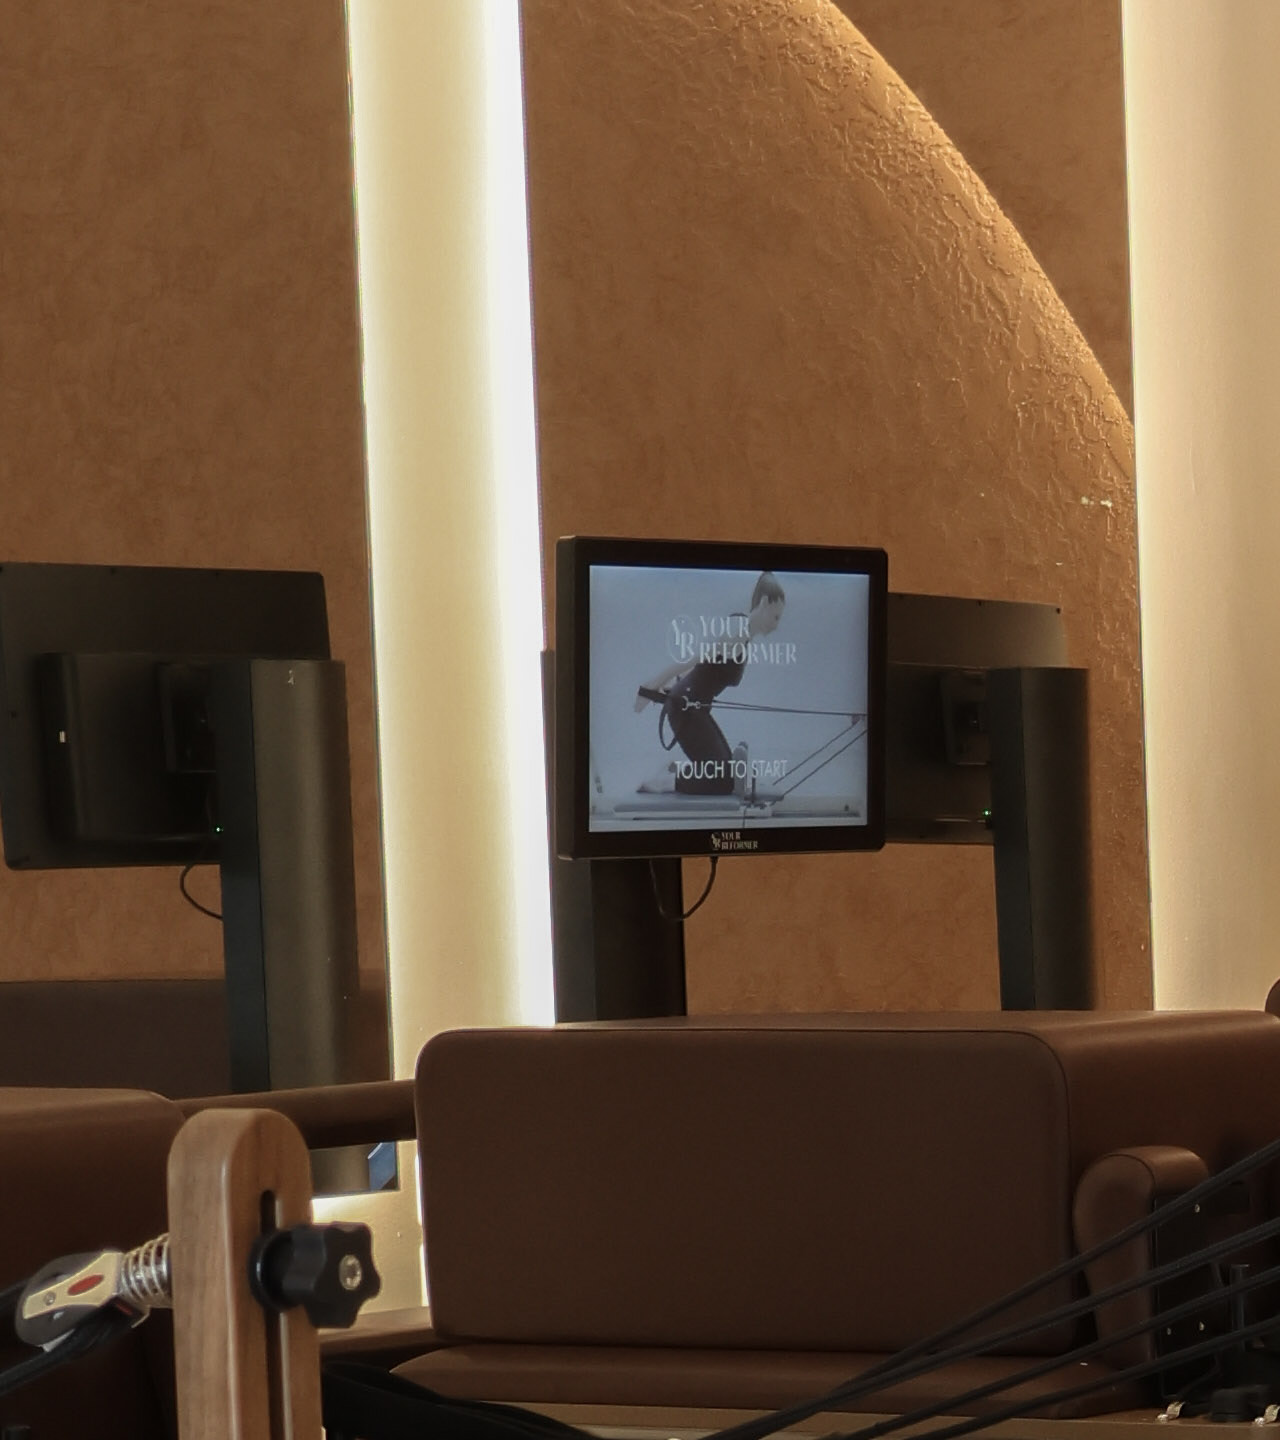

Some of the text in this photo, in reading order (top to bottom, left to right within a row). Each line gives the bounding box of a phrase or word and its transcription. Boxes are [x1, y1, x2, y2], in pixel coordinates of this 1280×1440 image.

[699, 615, 751, 639] YOUR
[699, 642, 797, 665] REFORMER
[675, 759, 788, 780] TOUCH TO START
